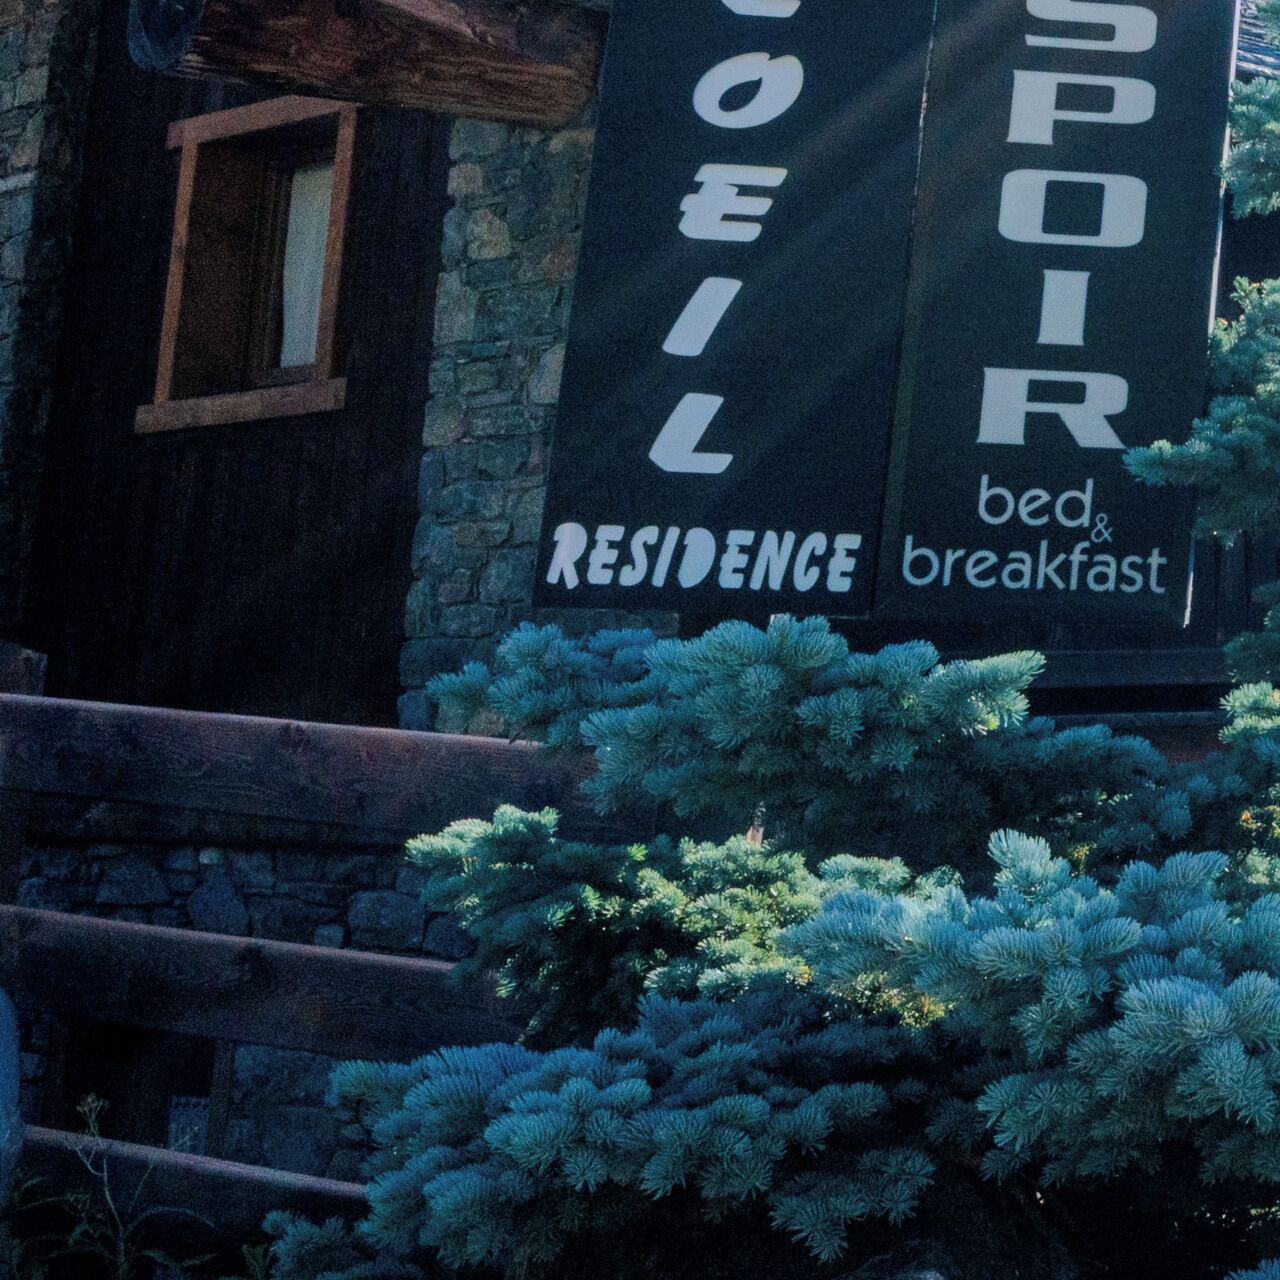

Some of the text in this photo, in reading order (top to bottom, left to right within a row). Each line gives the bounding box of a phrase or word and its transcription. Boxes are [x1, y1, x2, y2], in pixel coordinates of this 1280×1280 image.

[977, 473, 1094, 528] bed
[545, 521, 862, 593] RESIDENCE
[902, 534, 1168, 595] breakfast
